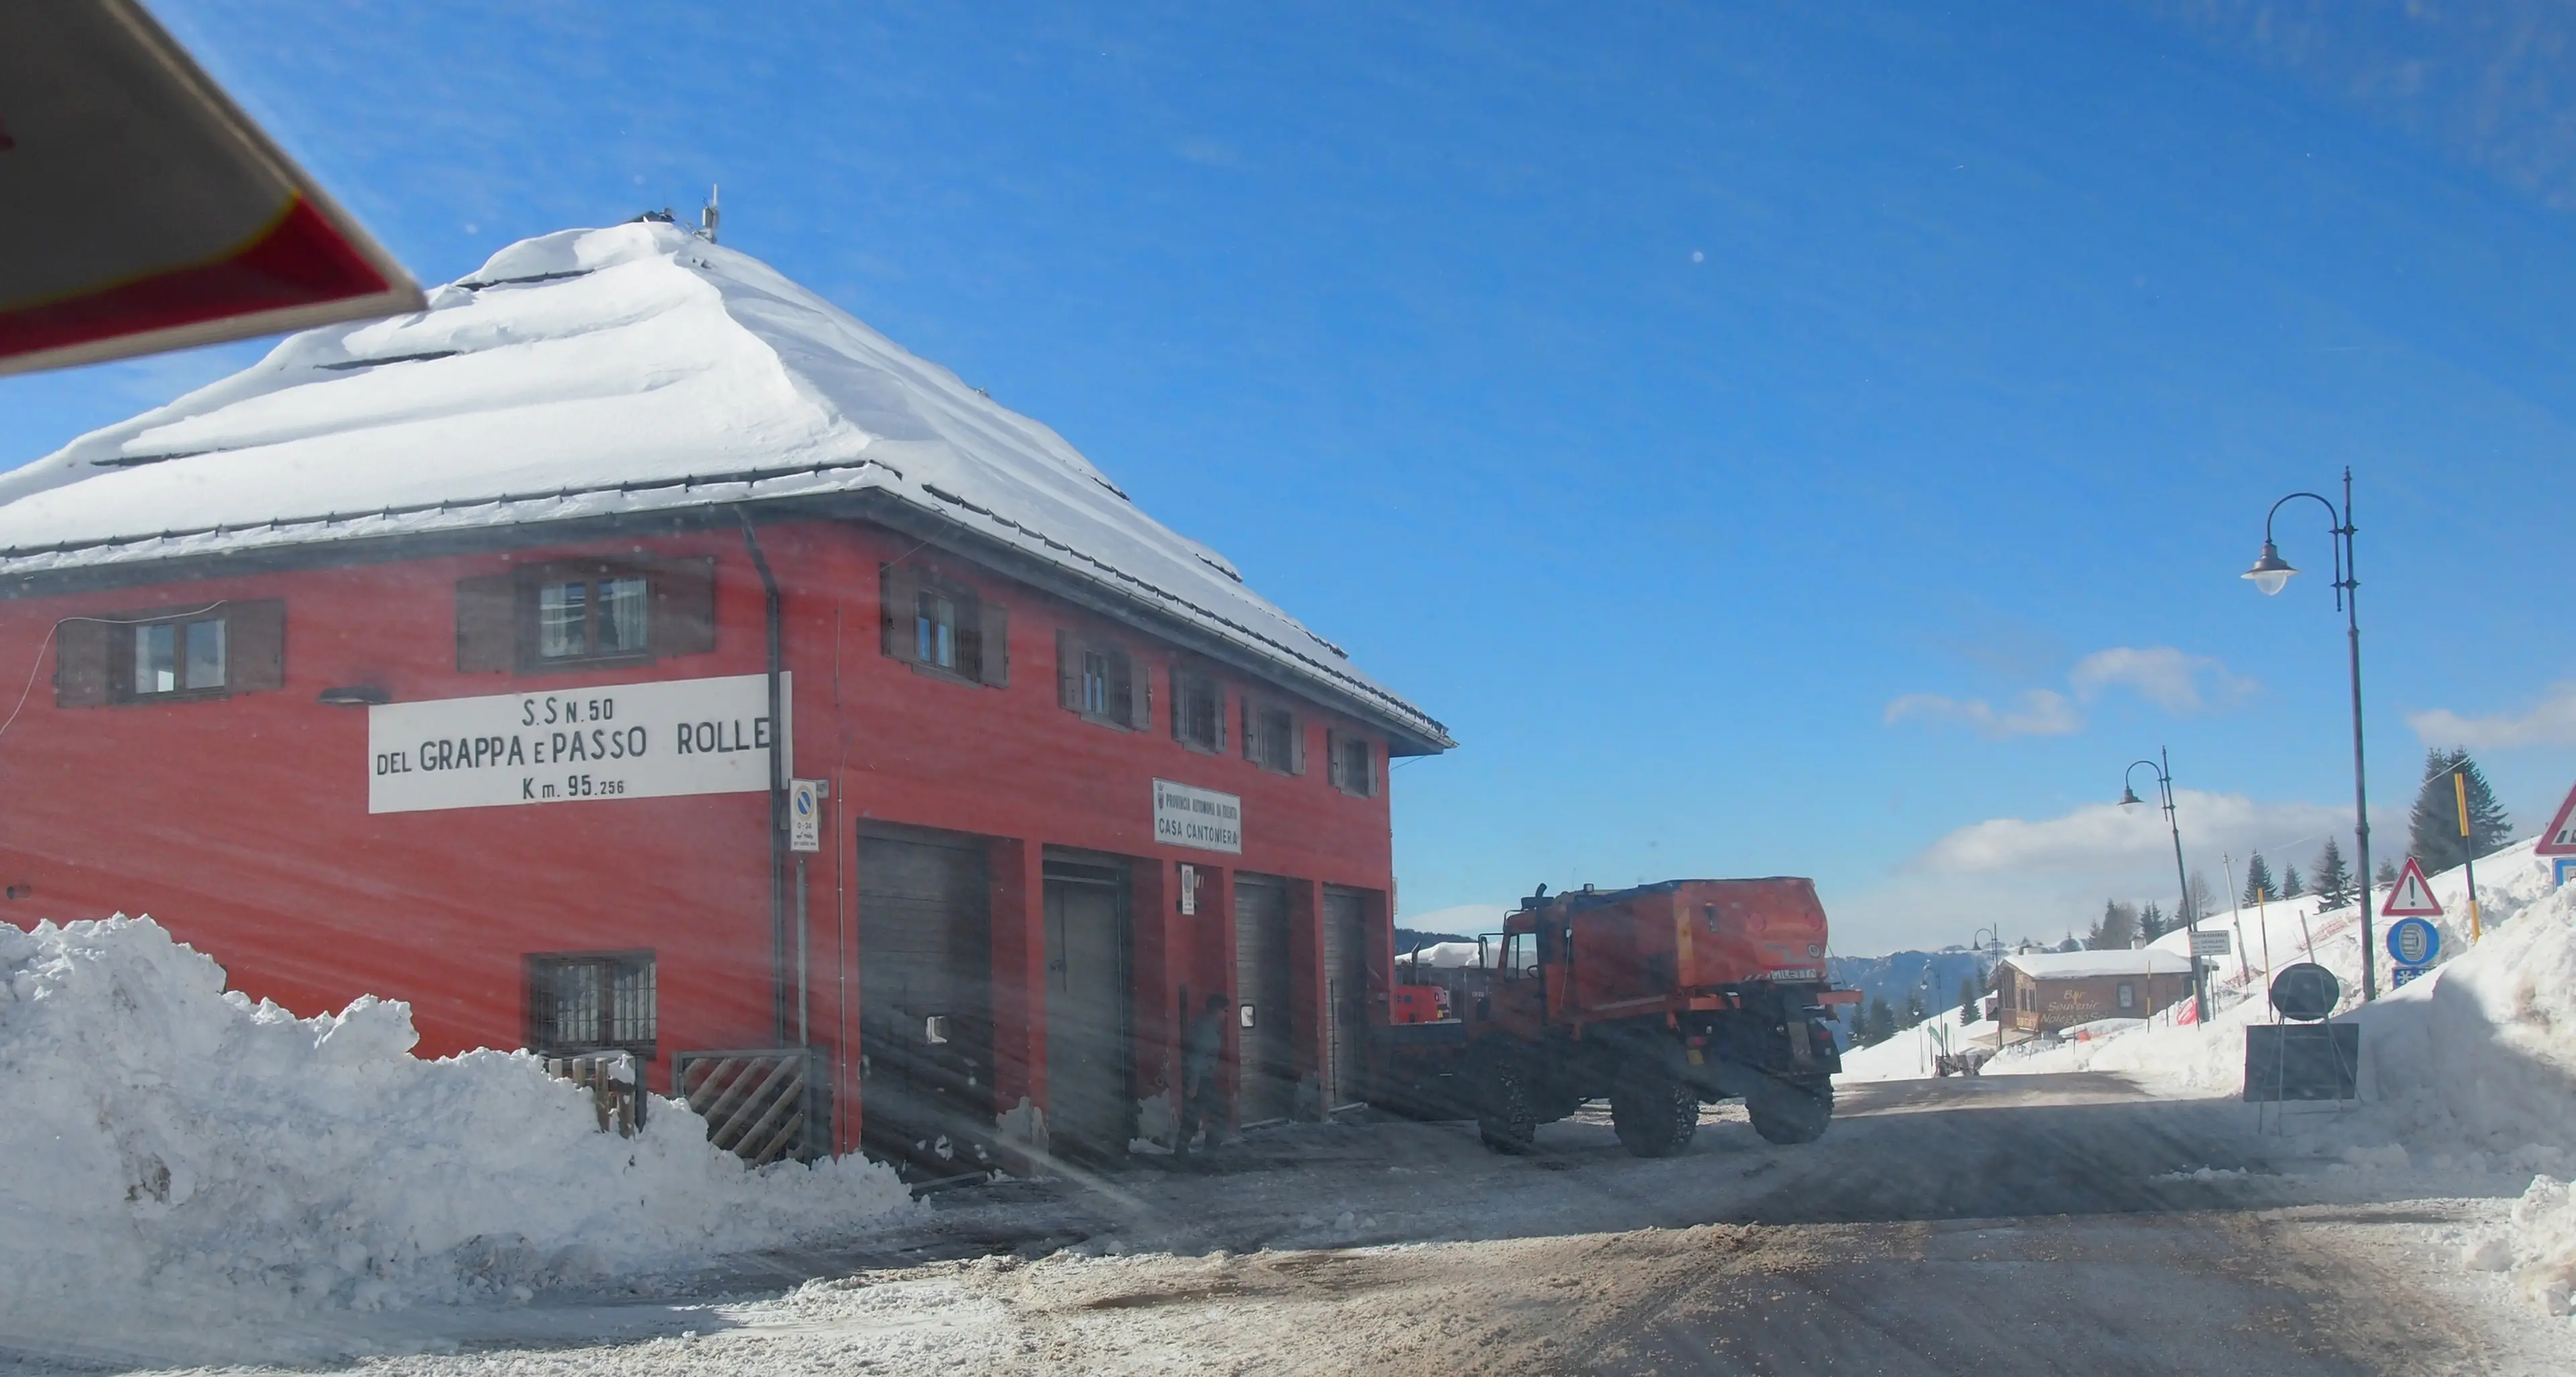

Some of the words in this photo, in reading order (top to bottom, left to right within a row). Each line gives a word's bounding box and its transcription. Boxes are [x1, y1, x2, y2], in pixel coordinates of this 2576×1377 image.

[377, 752, 412, 775] DEL
[420, 735, 525, 771] GRAPPA
[535, 742, 544, 763] E
[552, 726, 647, 763] PASSO
[678, 717, 770, 755] ROLLE
[1159, 817, 1182, 837] CASA
[1186, 823, 1238, 846] CANTONIERA
[2047, 1000, 2100, 1011] Souvenir
